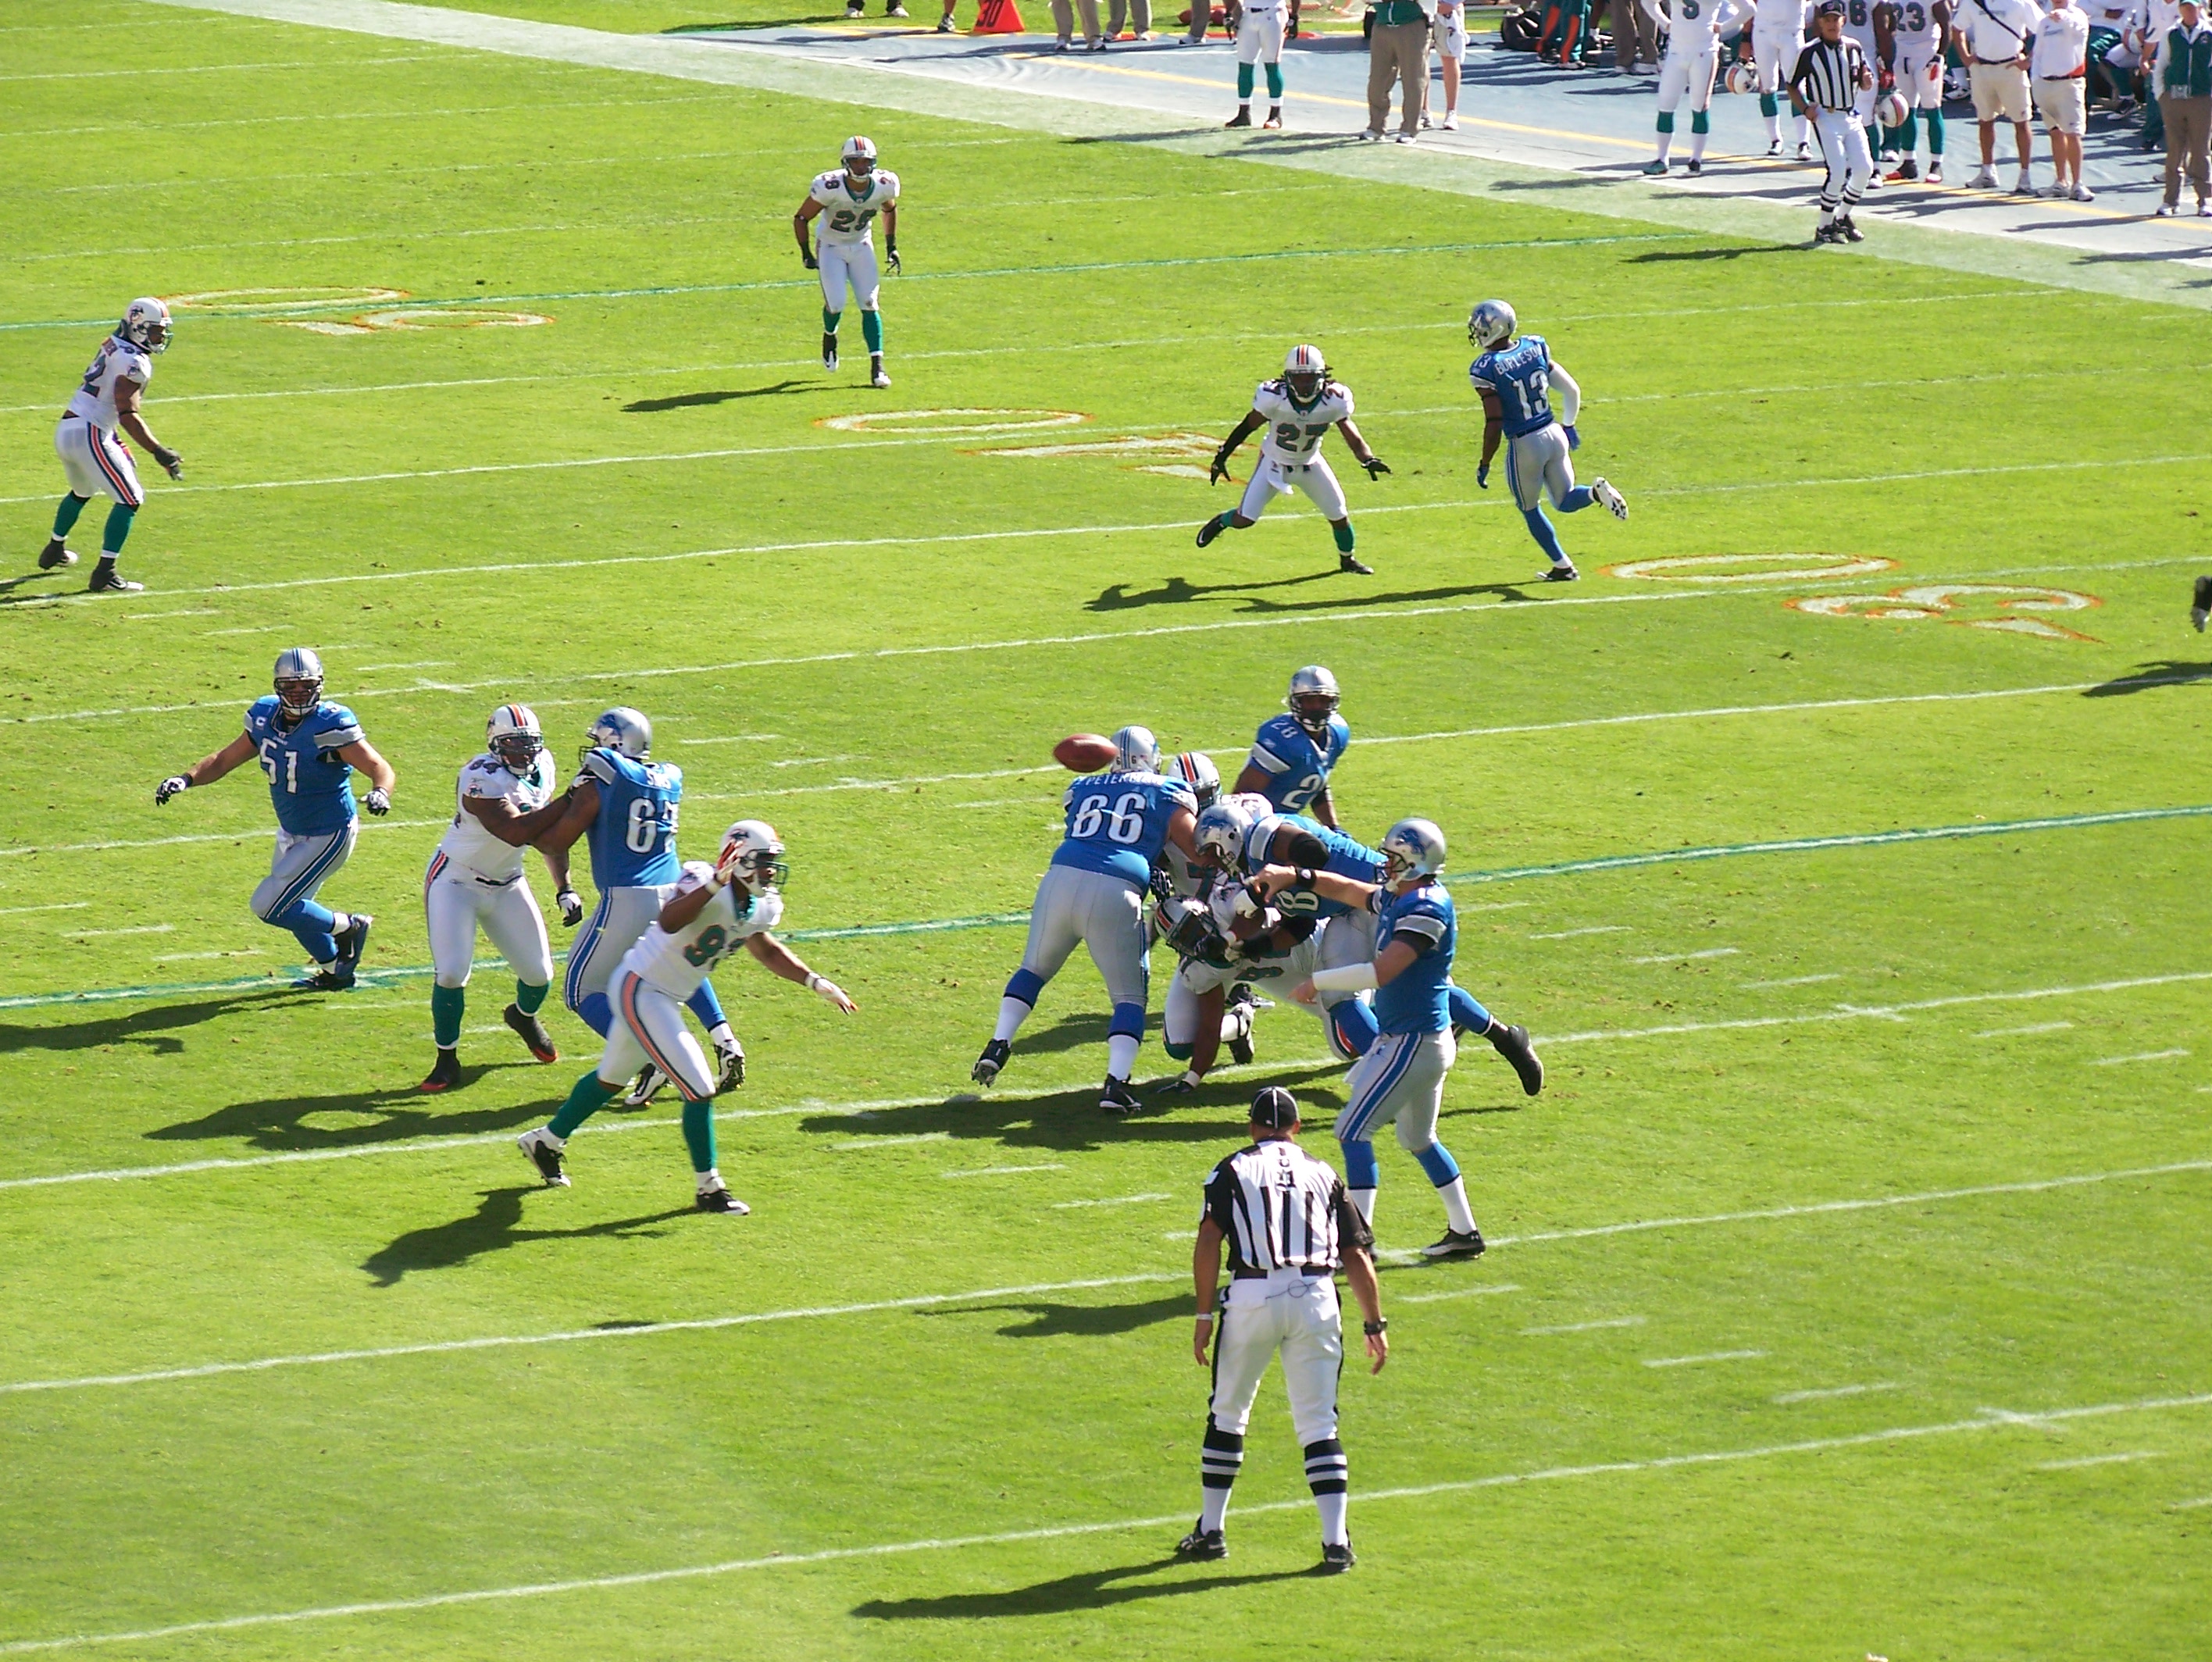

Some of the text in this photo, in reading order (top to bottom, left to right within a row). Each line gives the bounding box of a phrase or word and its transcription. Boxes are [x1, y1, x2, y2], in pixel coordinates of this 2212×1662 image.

[1888, 2, 1926, 31] 23
[1495, 343, 1543, 376] BURLESON
[1512, 369, 1550, 421] 13
[1275, 422, 1328, 452] 27
[259, 736, 298, 794] 51
[1071, 792, 1147, 845] 66
